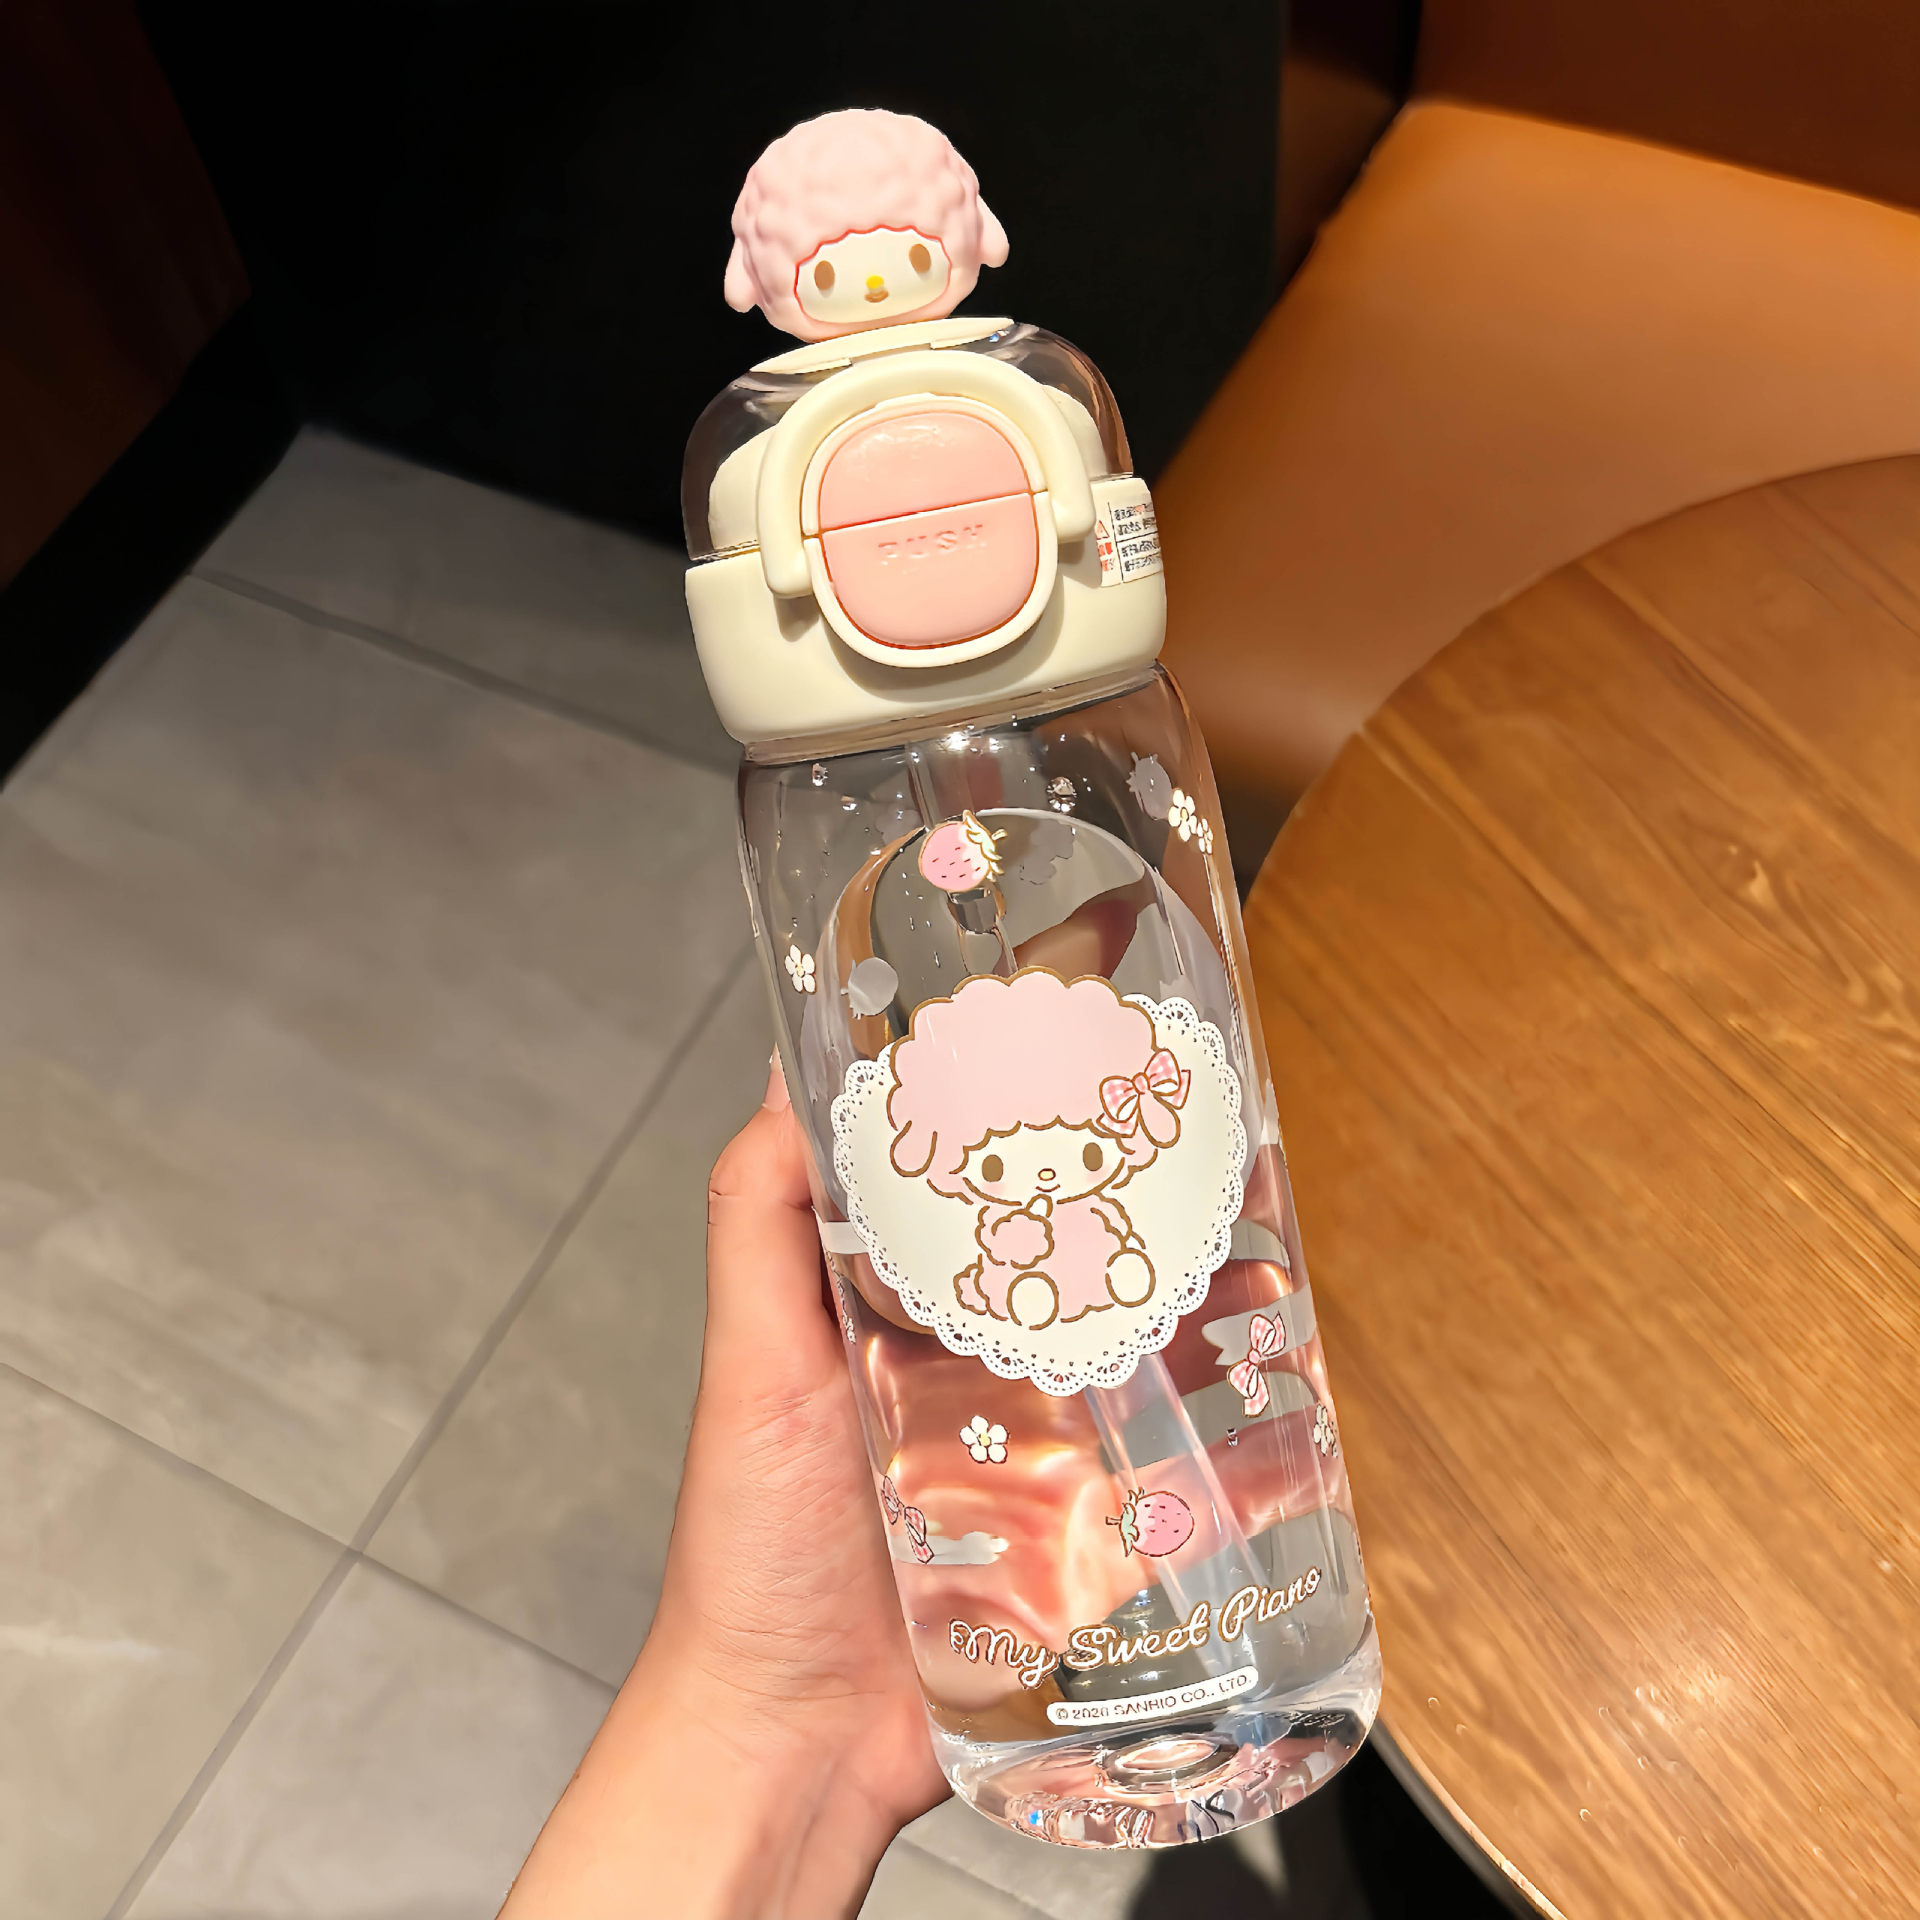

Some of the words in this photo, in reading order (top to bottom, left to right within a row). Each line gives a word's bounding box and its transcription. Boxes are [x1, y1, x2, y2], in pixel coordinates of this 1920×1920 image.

[878, 524, 986, 564] PUSH
[949, 1618, 1060, 1690] My
[1062, 1600, 1211, 1672] Sweet
[1217, 1566, 1322, 1644] Piano
